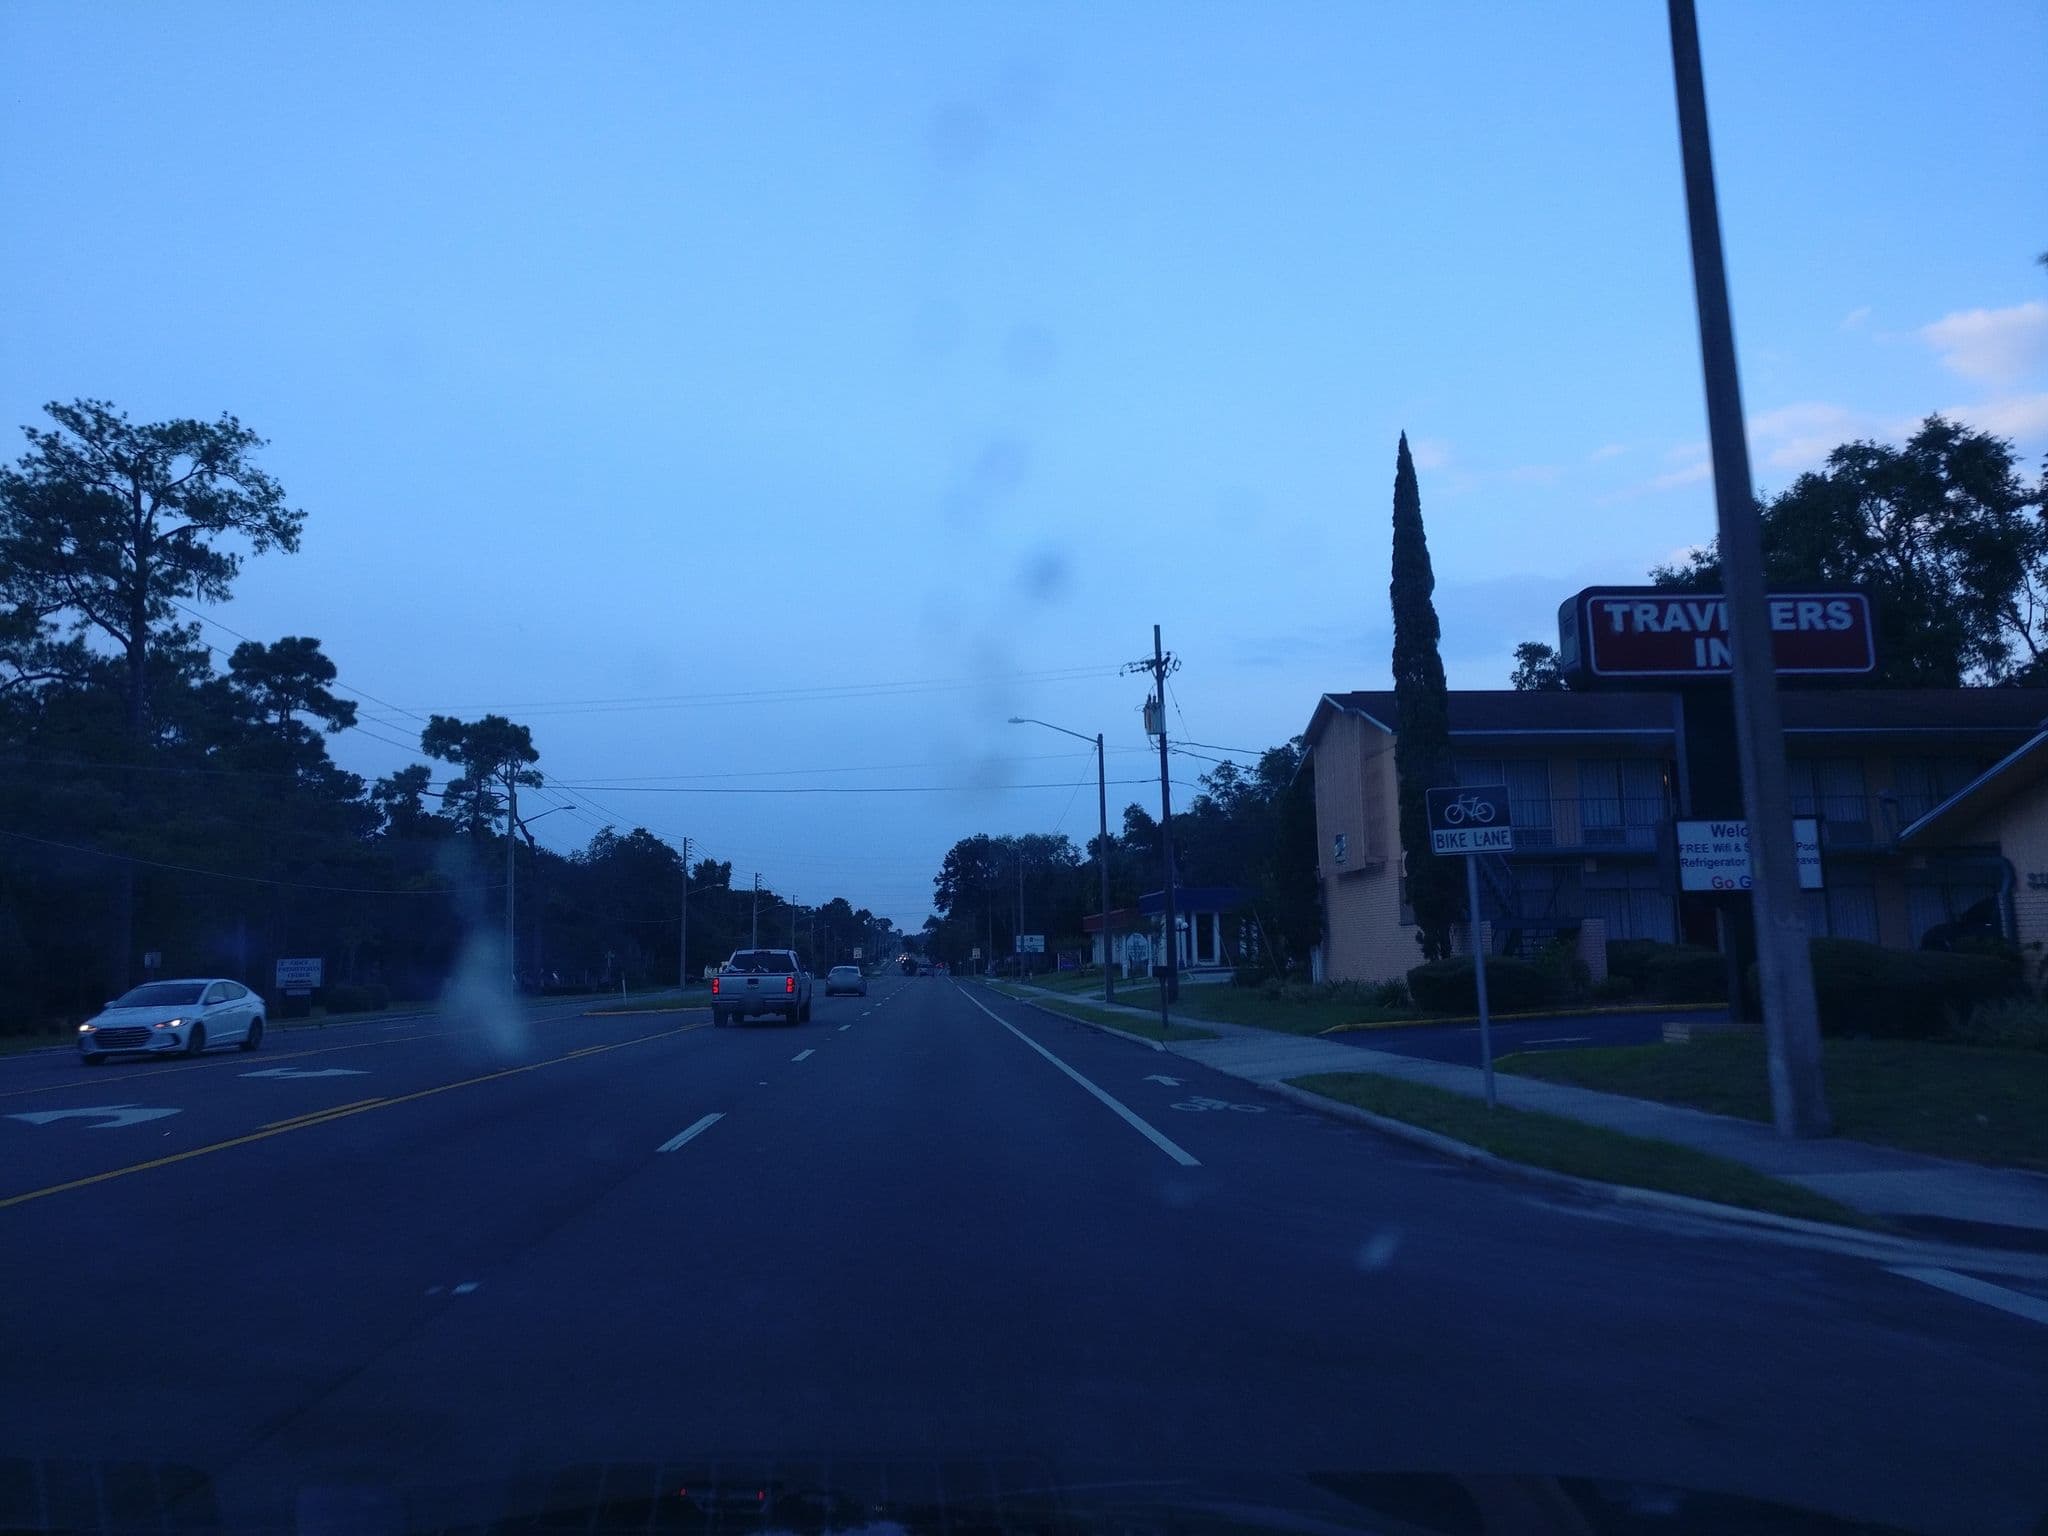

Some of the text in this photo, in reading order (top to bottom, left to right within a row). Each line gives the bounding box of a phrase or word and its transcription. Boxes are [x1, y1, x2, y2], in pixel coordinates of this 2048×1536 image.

[1604, 601, 1854, 633] TRAVERS
[1695, 637, 1735, 668] IN
[1711, 823, 1751, 838] Welc
[1436, 830, 1510, 848] BIKE LANE
[1679, 843, 1709, 854] FREE
[1681, 857, 1746, 870] Refrigerator
[1712, 875, 1735, 889] Go
